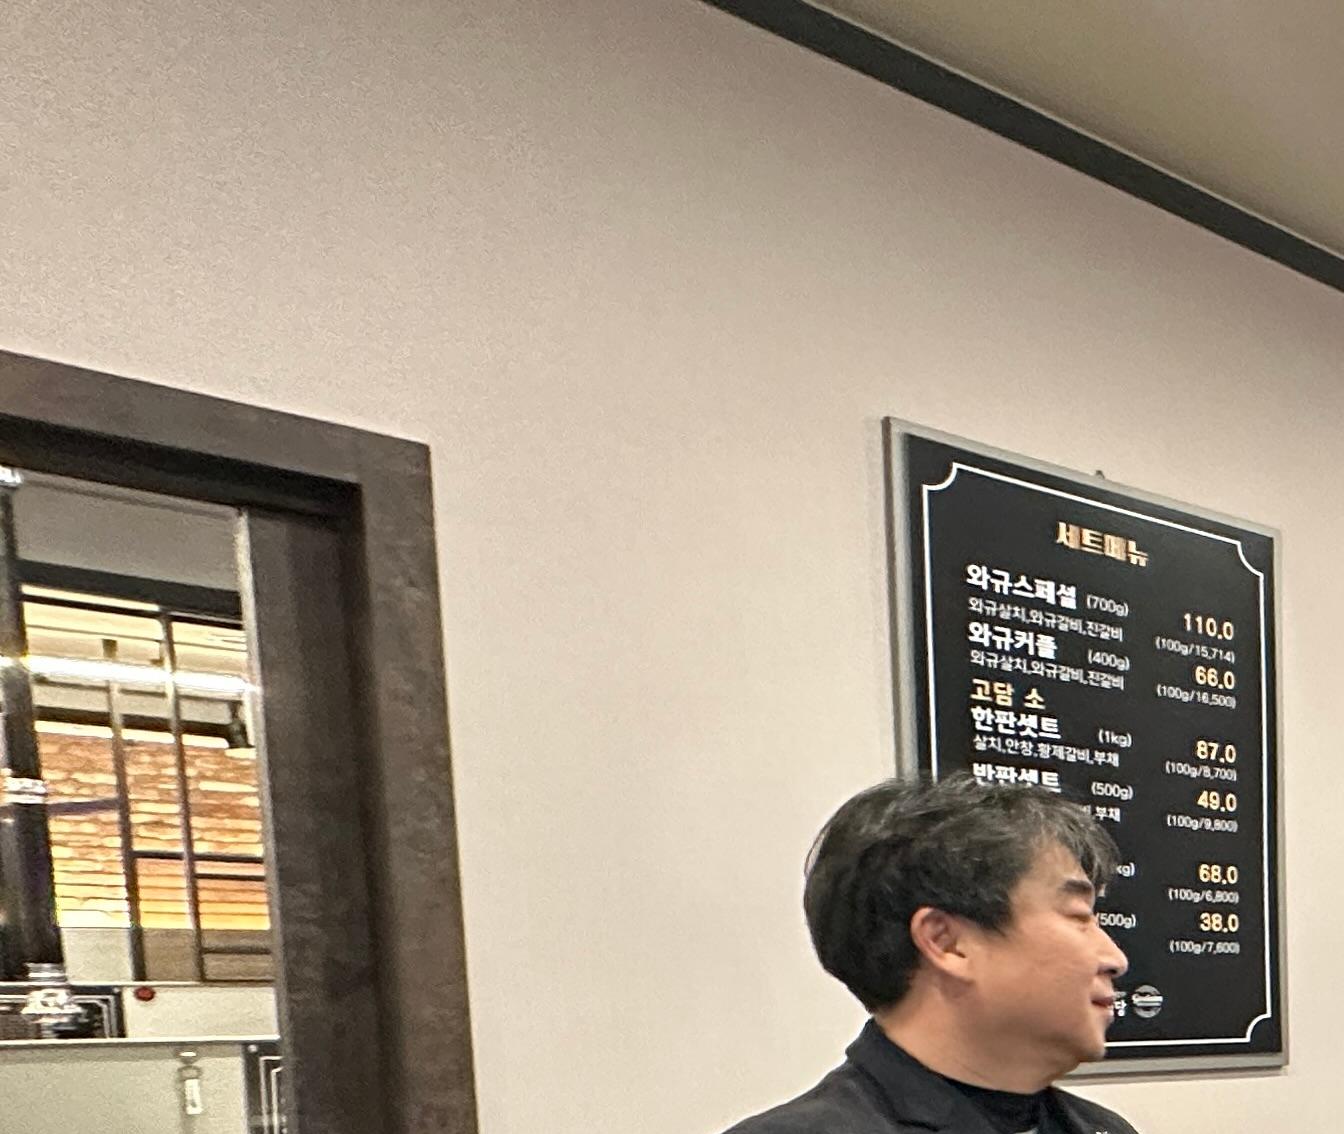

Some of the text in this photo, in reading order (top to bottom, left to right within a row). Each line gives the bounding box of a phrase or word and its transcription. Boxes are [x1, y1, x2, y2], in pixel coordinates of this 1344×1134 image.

[1055, 521, 1149, 567] 세트메뉴
[966, 564, 1234, 640] 와규스페셜 (700g) 110.0
[968, 622, 1235, 690] 와규커플 (400g) 66.0
[970, 678, 1046, 709] 고담 소
[970, 706, 1237, 763] 한판셋트 (1kg) 87.0
[1091, 781, 1133, 800] (500g)
[1197, 790, 1237, 812] 49.0
[1199, 863, 1238, 885] 68.0
[1096, 912, 1239, 932] (500g) 38.0
